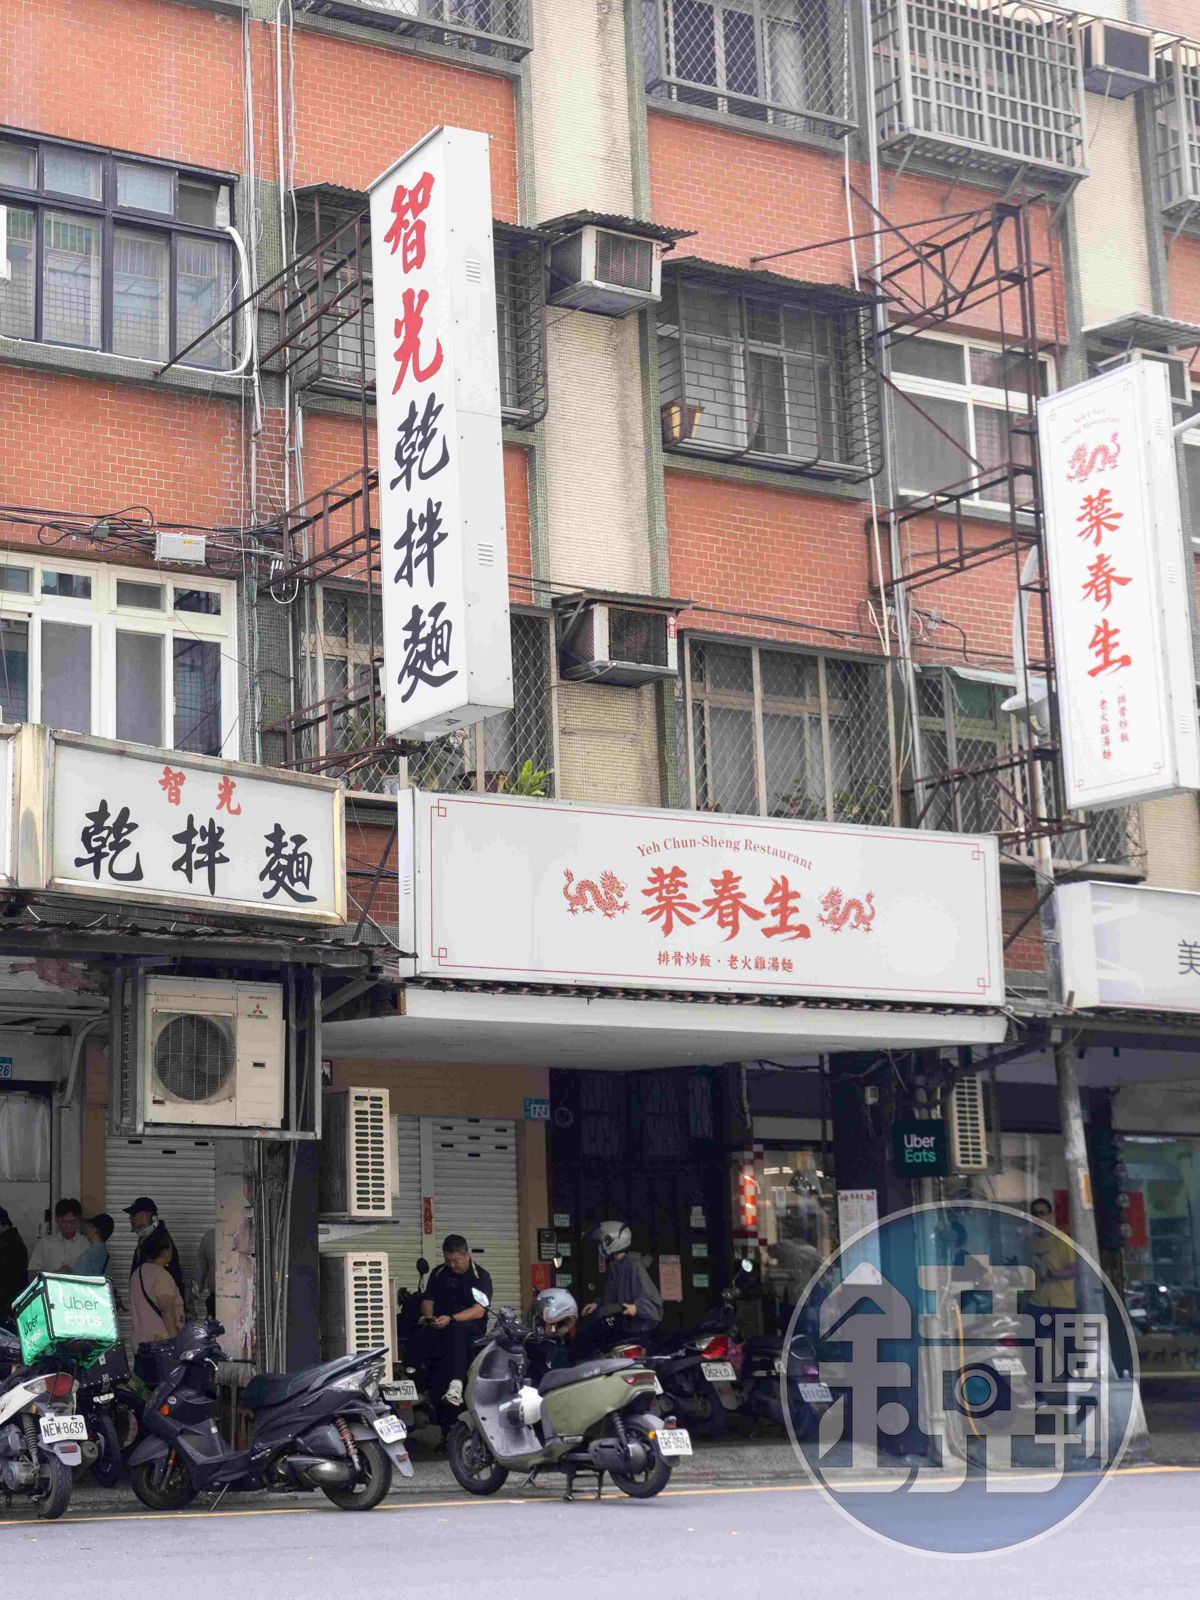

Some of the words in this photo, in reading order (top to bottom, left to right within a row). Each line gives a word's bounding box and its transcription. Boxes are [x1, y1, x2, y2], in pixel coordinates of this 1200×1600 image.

[1076, 488, 1133, 678] 葉春生
[158, 767, 242, 817] 智光
[73, 799, 320, 903] 乾拌麵
[637, 841, 661, 858] Yeh
[663, 835, 741, 852] Chun-Sheng
[744, 838, 813, 871] Restaurant
[641, 865, 811, 942] 葉春生
[1178, 939, 1200, 977] 美
[903, 1133, 936, 1149] Uber
[904, 1149, 937, 1163] Eats
[63, 1295, 99, 1311] Uber
[63, 1312, 102, 1327] Eats
[42, 1421, 84, 1438] NEW-8639
